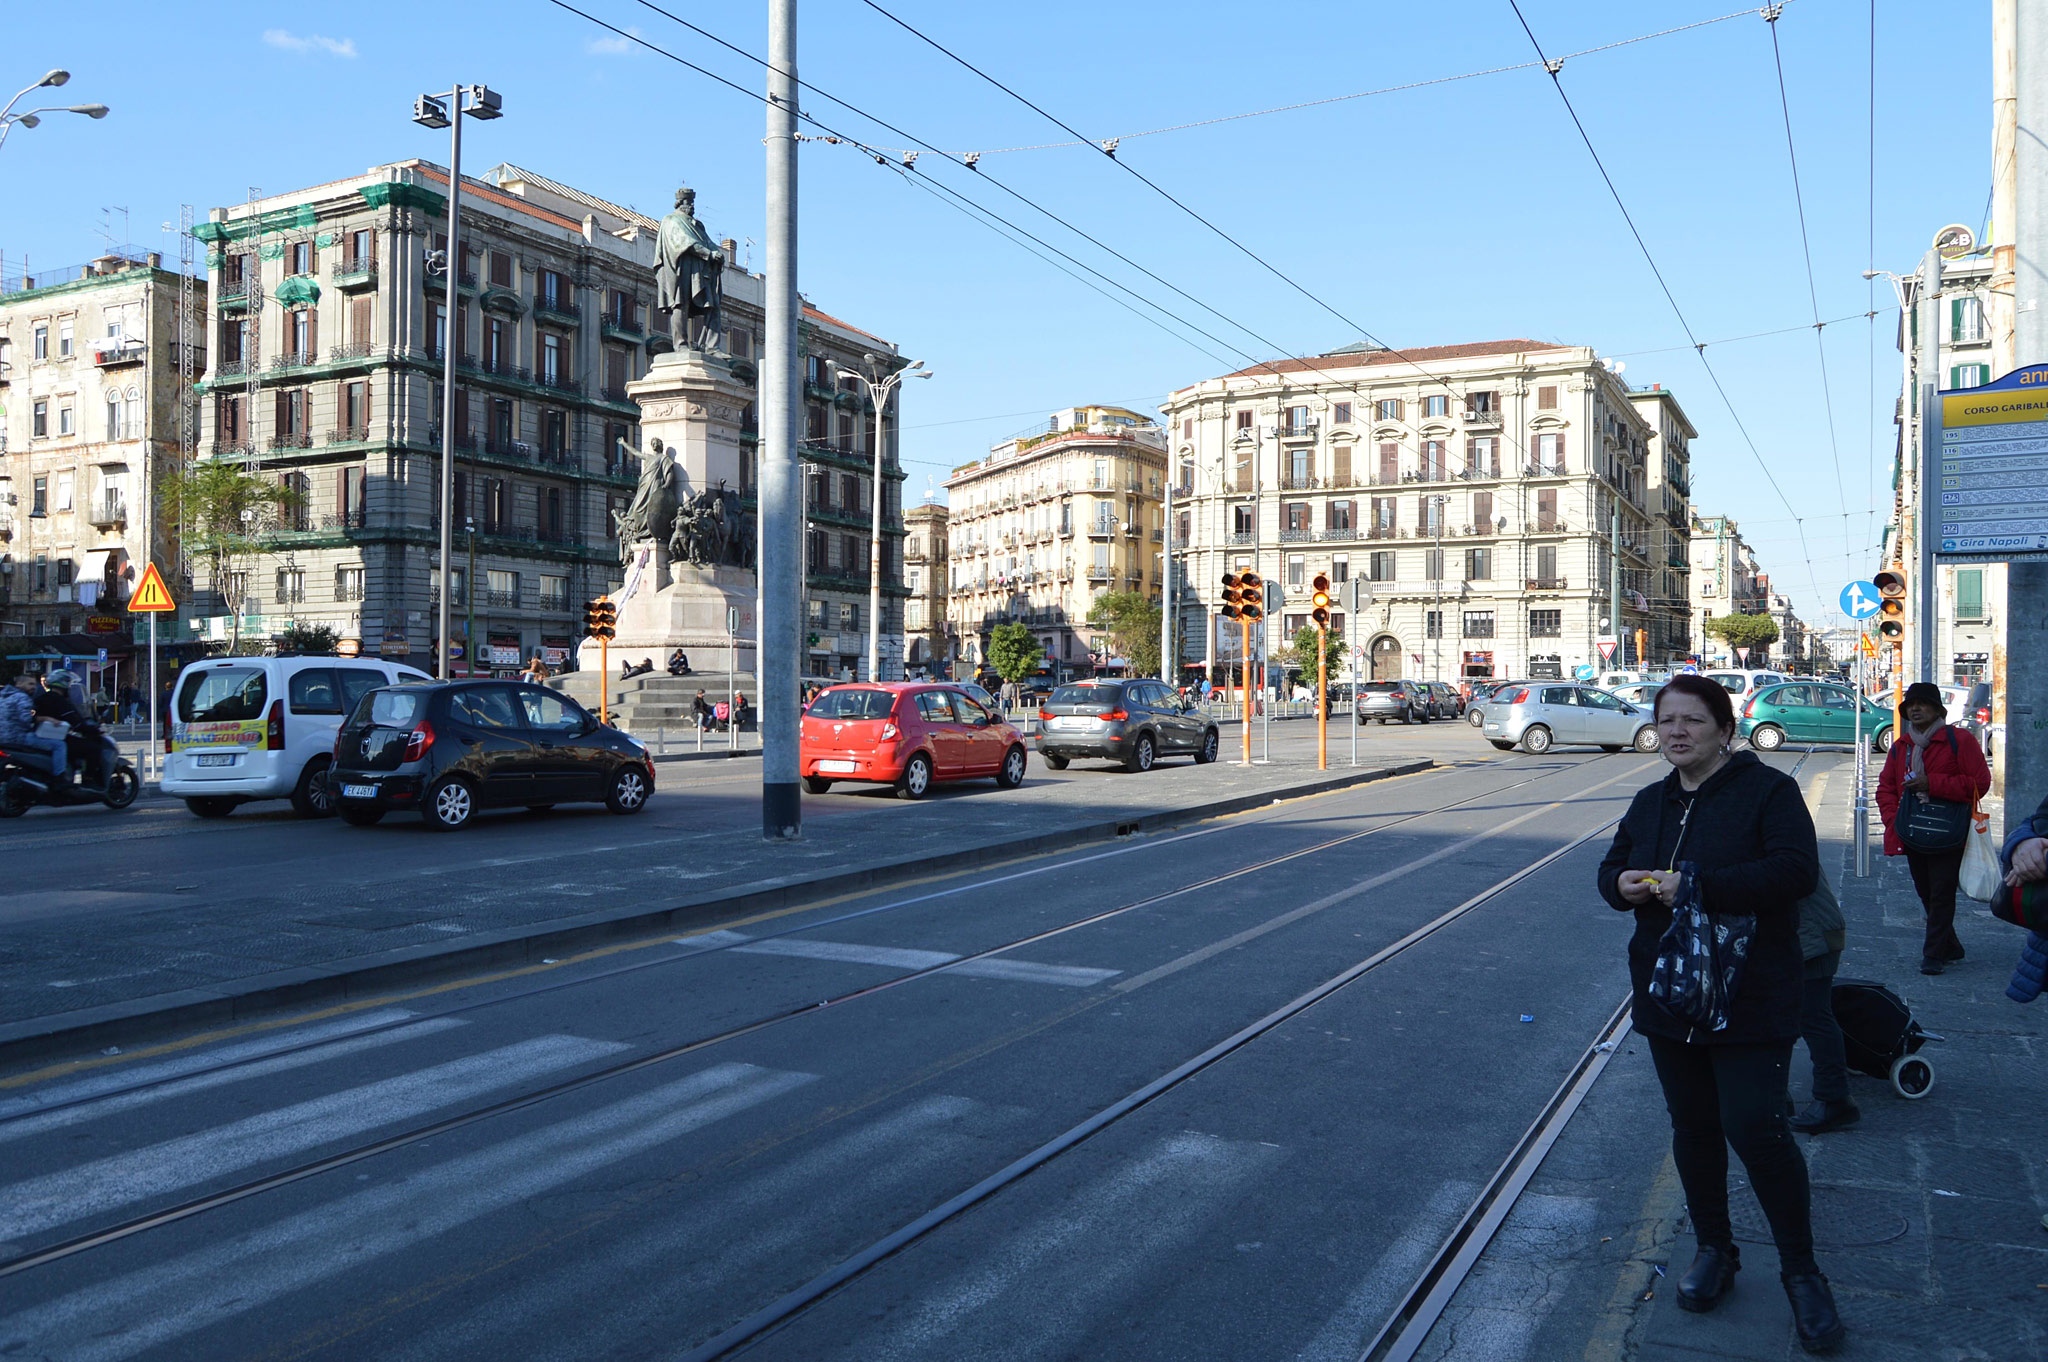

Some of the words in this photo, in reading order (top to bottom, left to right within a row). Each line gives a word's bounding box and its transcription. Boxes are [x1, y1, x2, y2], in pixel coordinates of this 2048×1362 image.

[1964, 405, 1999, 415] CORSO
[1960, 539, 1984, 547] Gira
[1988, 537, 2029, 548] Napoli
[1942, 554, 1986, 562] FERMATA
[91, 616, 120, 624] PIZZERIA
[101, 651, 106, 660] P
